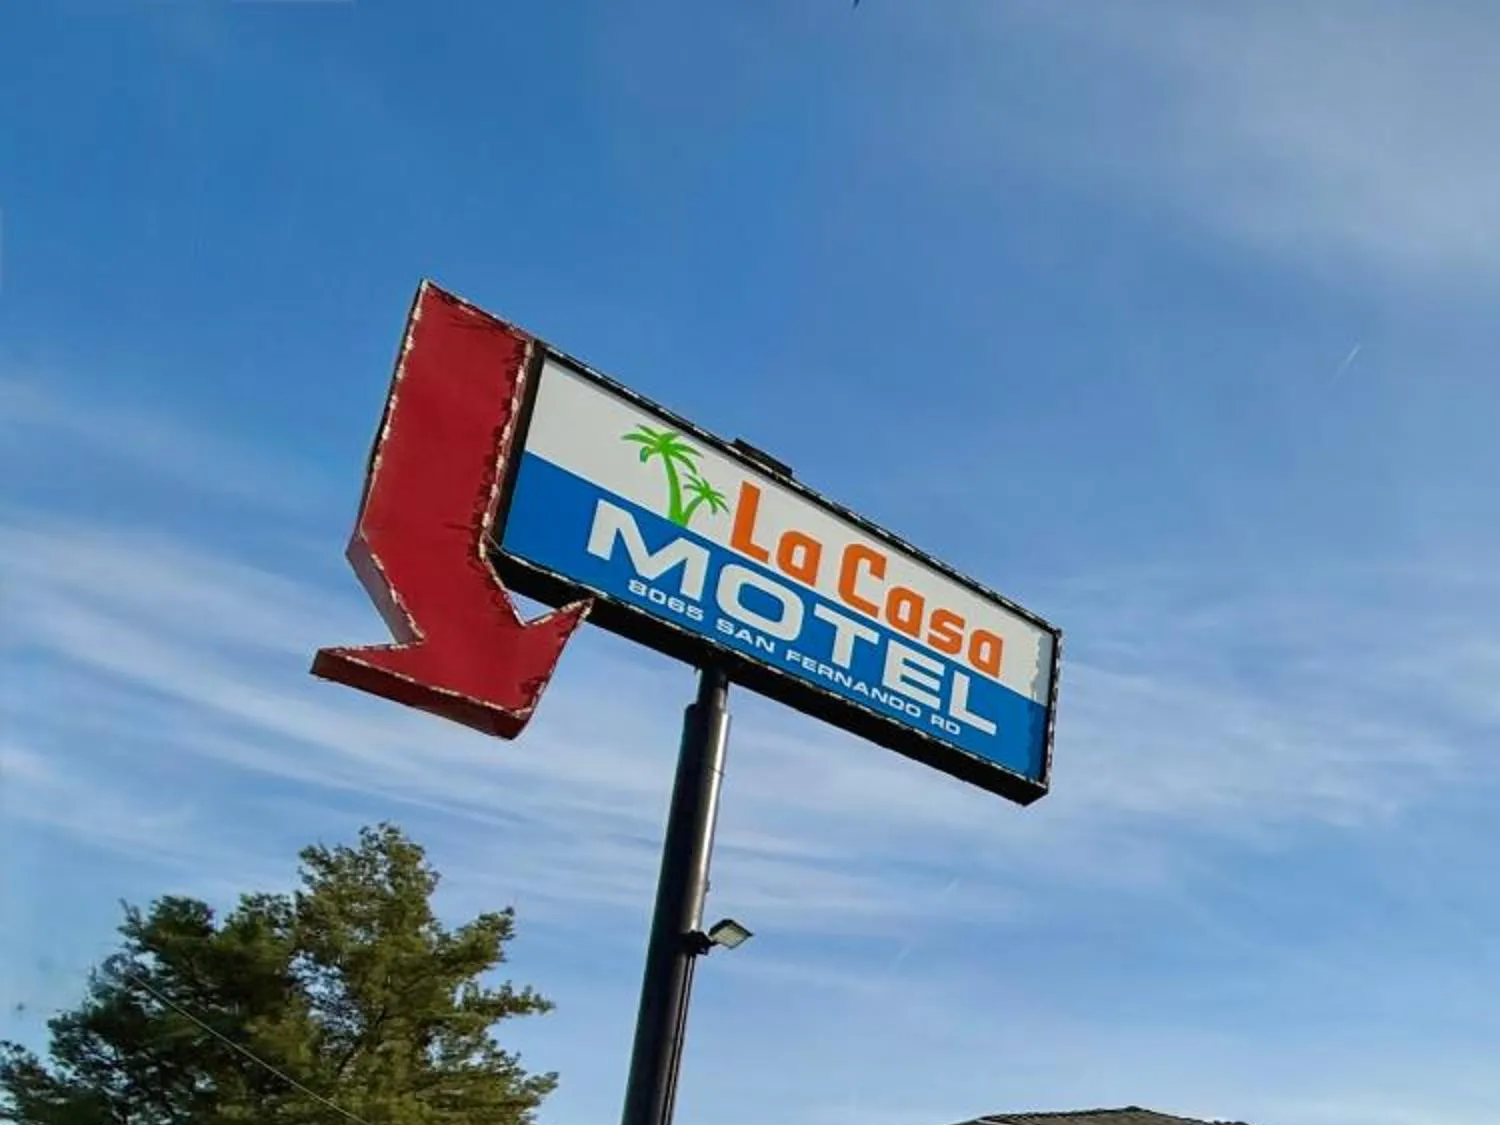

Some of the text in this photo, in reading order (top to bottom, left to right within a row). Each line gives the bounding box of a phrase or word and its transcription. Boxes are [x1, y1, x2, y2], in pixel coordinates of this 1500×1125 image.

[586, 498, 998, 737] MOTEL
[627, 578, 962, 736] 8065 SAN FERNANDO RD
[729, 480, 1004, 679] La Casa
